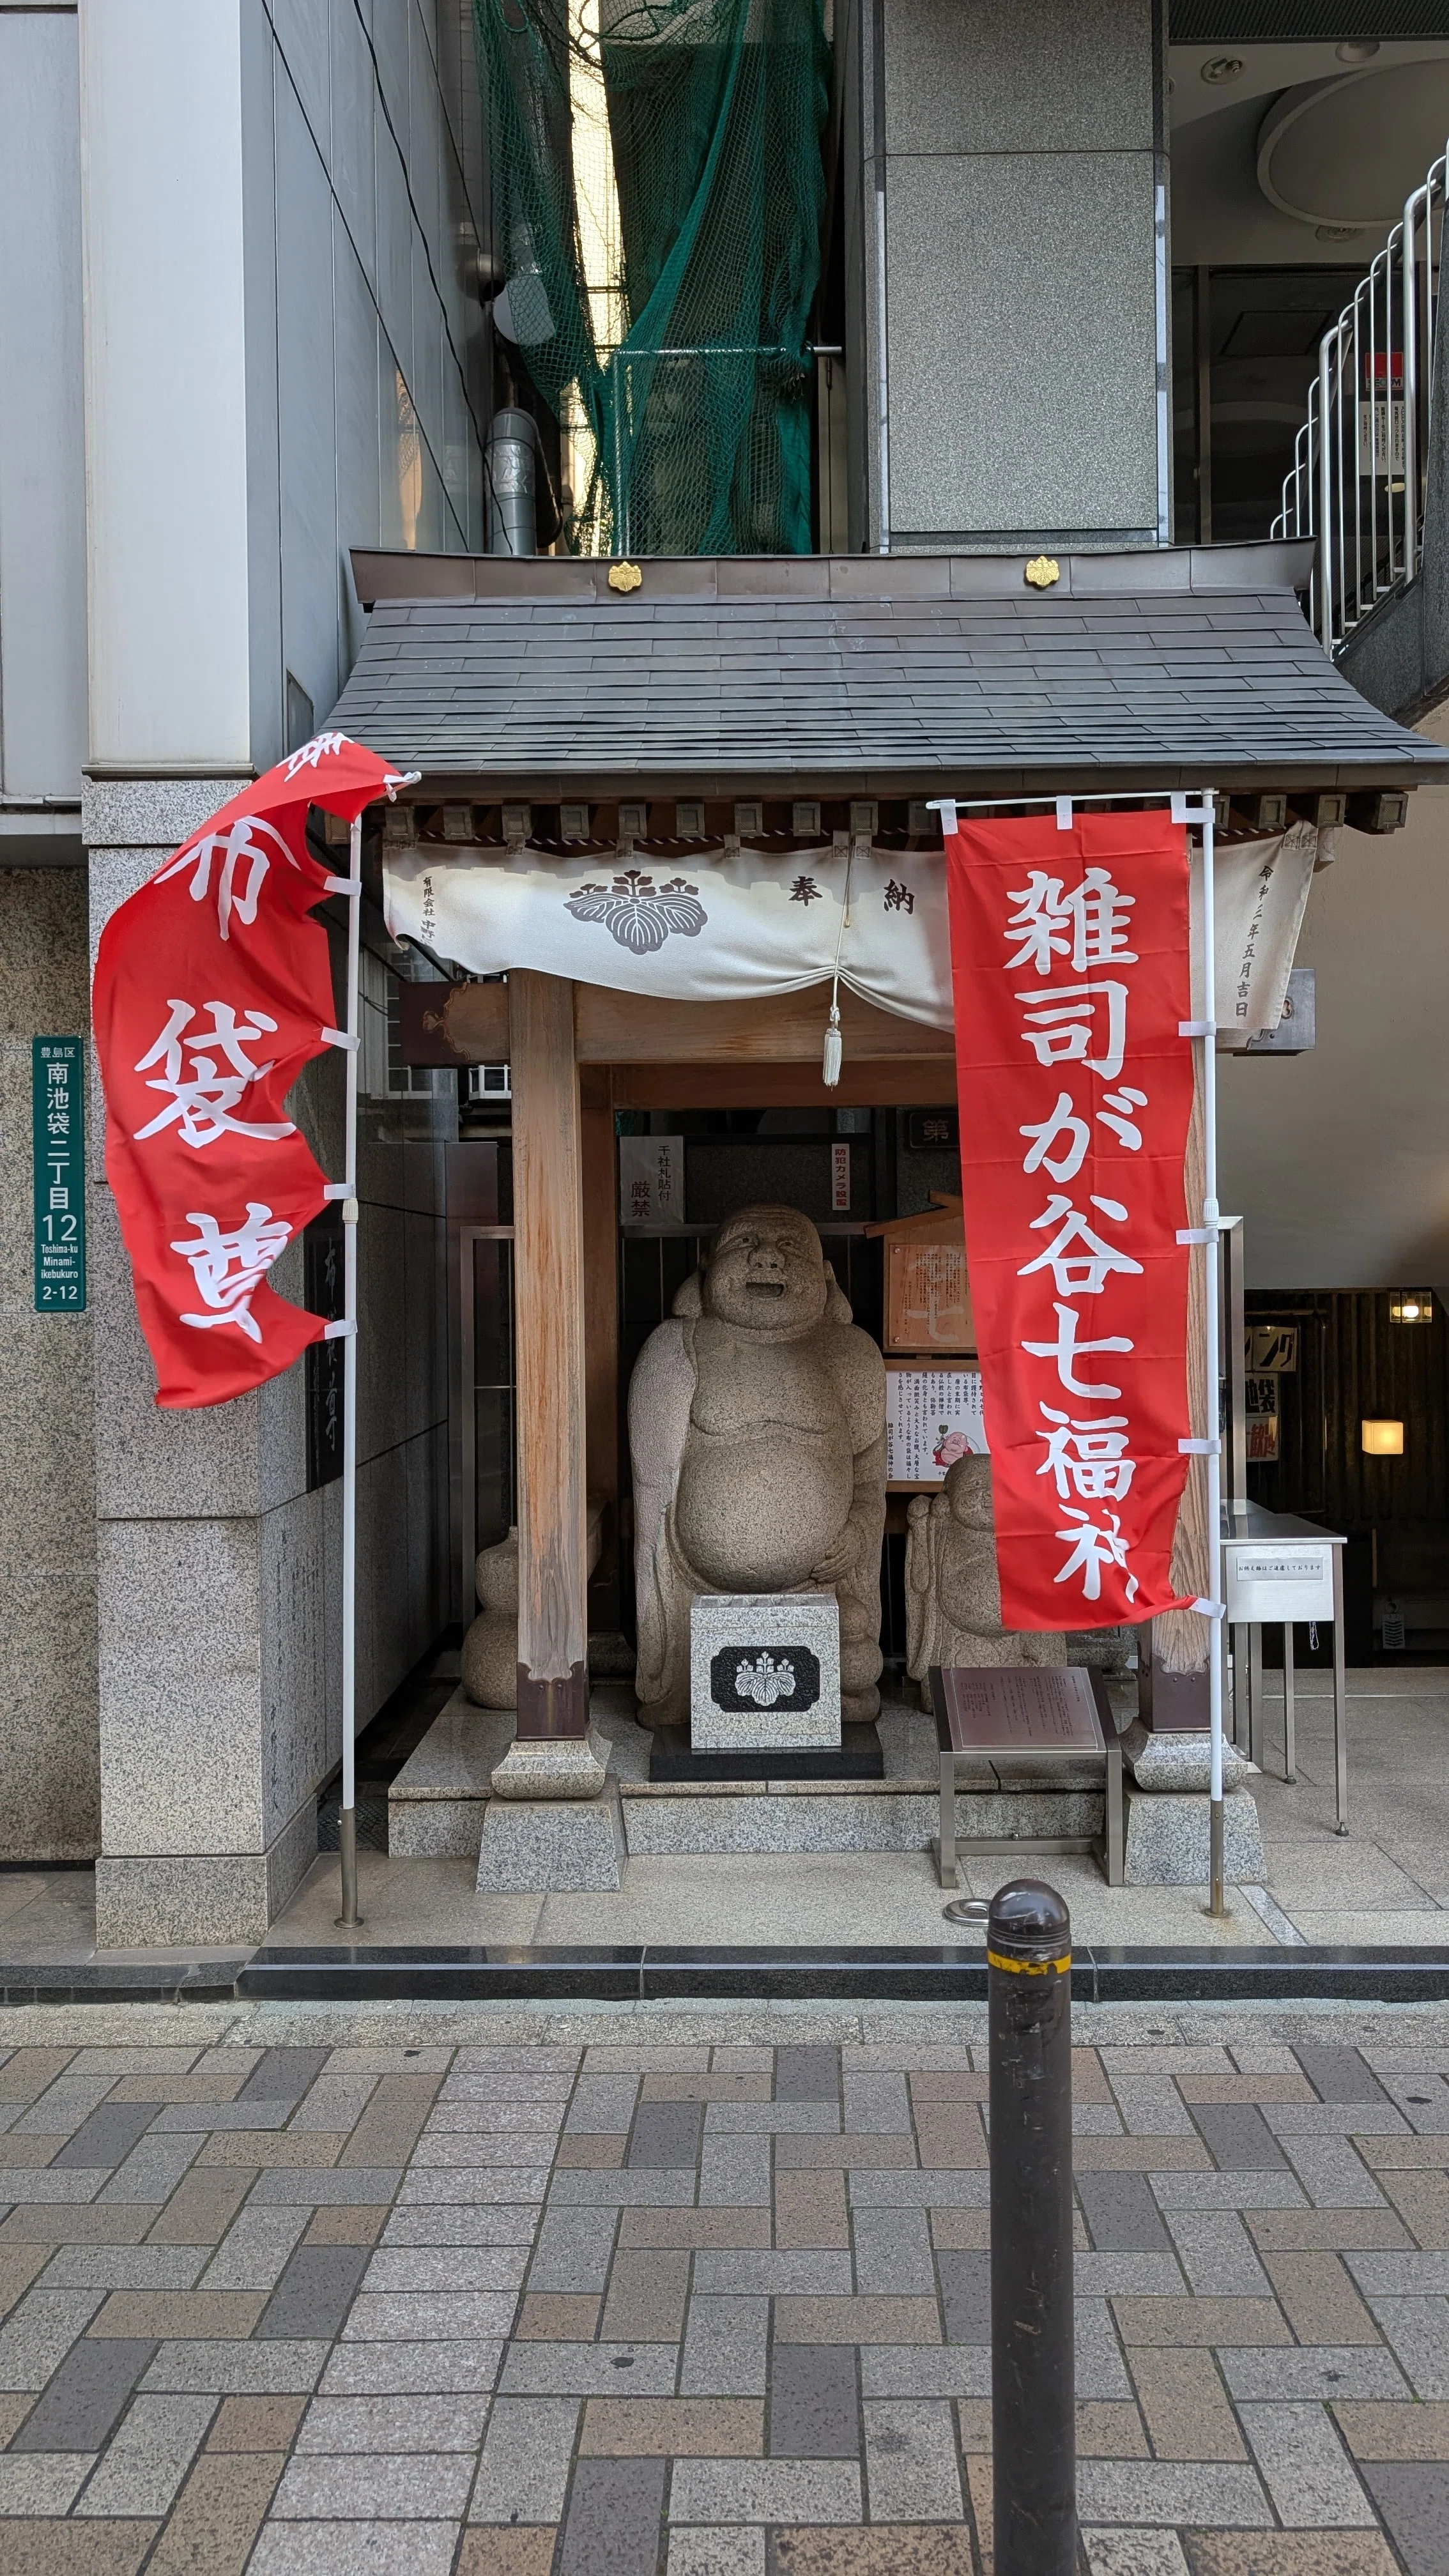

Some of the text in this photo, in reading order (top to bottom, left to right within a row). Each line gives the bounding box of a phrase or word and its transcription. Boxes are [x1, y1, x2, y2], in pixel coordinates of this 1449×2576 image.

[422, 876, 436, 917] 有限会社
[1236, 865, 1274, 1017] 令和三年五月吉日
[40, 1046, 75, 1058] 豊島区
[46, 1062, 70, 1210] 南池袋二丁目
[657, 1145, 671, 1201] 千社札貼付
[834, 1148, 847, 1206] 防犯カメラ設置
[631, 1180, 651, 1217] 厳禁
[42, 1215, 77, 1241] 12
[42, 1244, 79, 1254] Toshima-ku
[43, 1256, 75, 1266] Minami-
[41, 1268, 79, 1279] ikebukuro
[42, 1286, 77, 1300] 2-12
